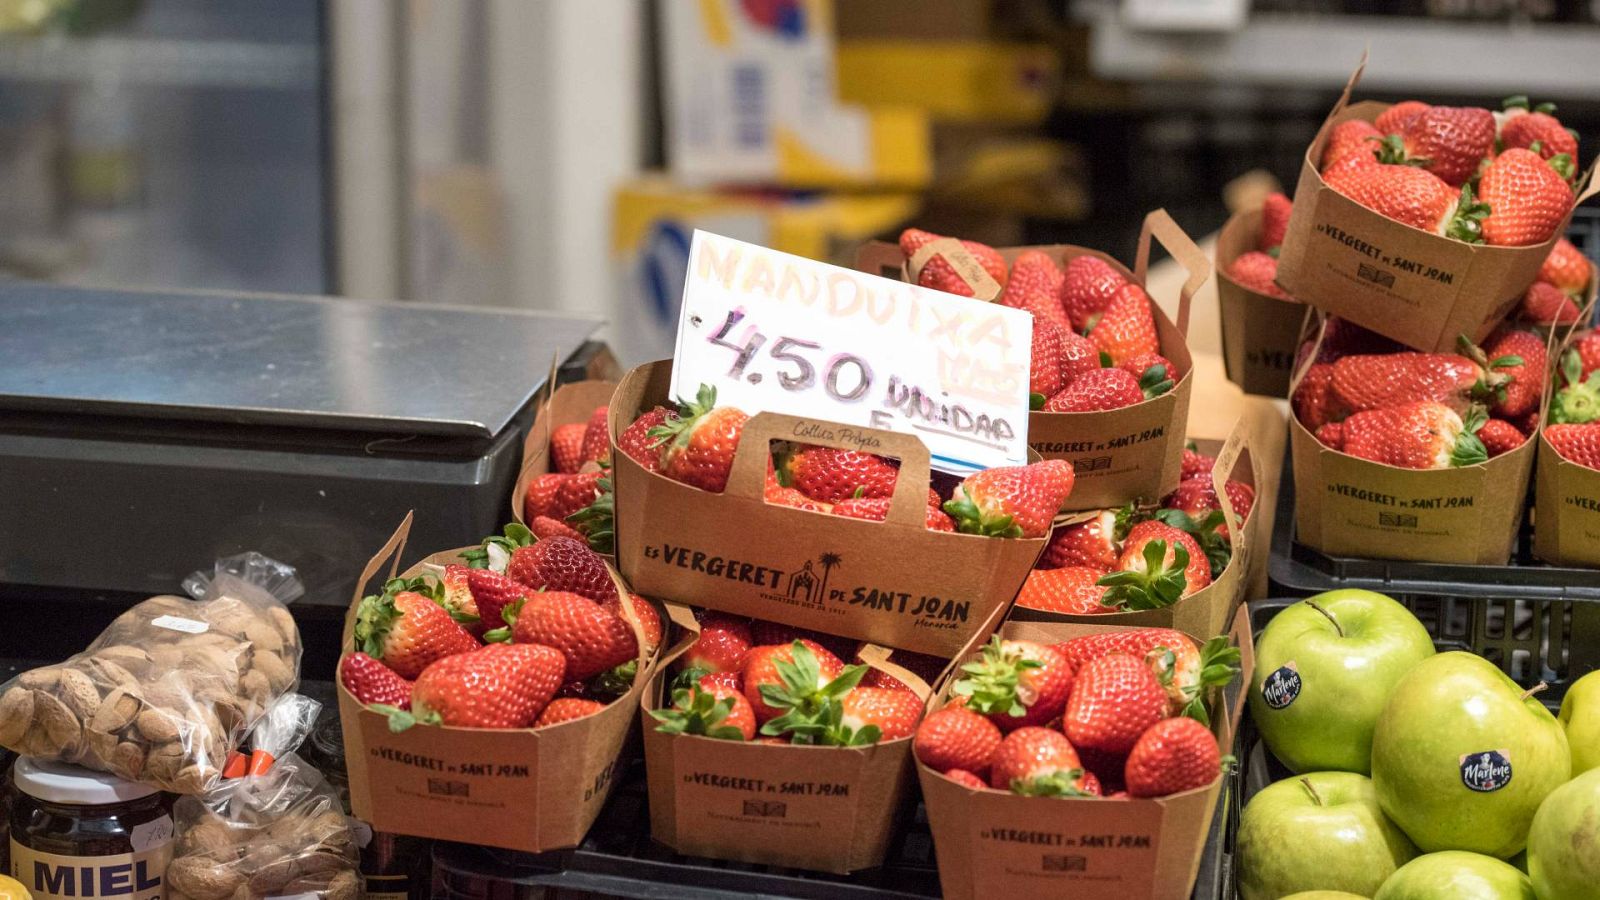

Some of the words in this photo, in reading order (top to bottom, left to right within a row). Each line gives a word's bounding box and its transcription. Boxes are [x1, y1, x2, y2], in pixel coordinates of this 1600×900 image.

[1325, 224, 1381, 260] VERGERET
[1393, 257, 1425, 275] SANT
[1423, 267, 1454, 284] JOAN
[706, 306, 873, 403] 4.50
[1107, 435, 1136, 449] SANT
[1137, 426, 1164, 442] JOAN
[1336, 483, 1396, 506] VERGERET
[1411, 498, 1443, 509] SANT
[1443, 496, 1473, 509] JOAN
[664, 544, 785, 589] VERGERET
[829, 589, 847, 602] DE
[848, 587, 912, 613] SANT
[911, 596, 970, 622] JOAN
[915, 619, 960, 631] Menorca
[1264, 675, 1298, 704] Marlene
[378, 746, 444, 772] VERGERET
[460, 765, 493, 777] SANT
[496, 765, 529, 778] JOAN
[1464, 762, 1510, 786] Marlene
[693, 772, 764, 792] VERGERET
[779, 782, 815, 795] SANT
[816, 783, 849, 796] JOAN
[991, 828, 1062, 846] VERGERET
[1080, 835, 1114, 848] SANT
[1116, 835, 1150, 848] JOAN
[34, 860, 161, 896] MIEL
